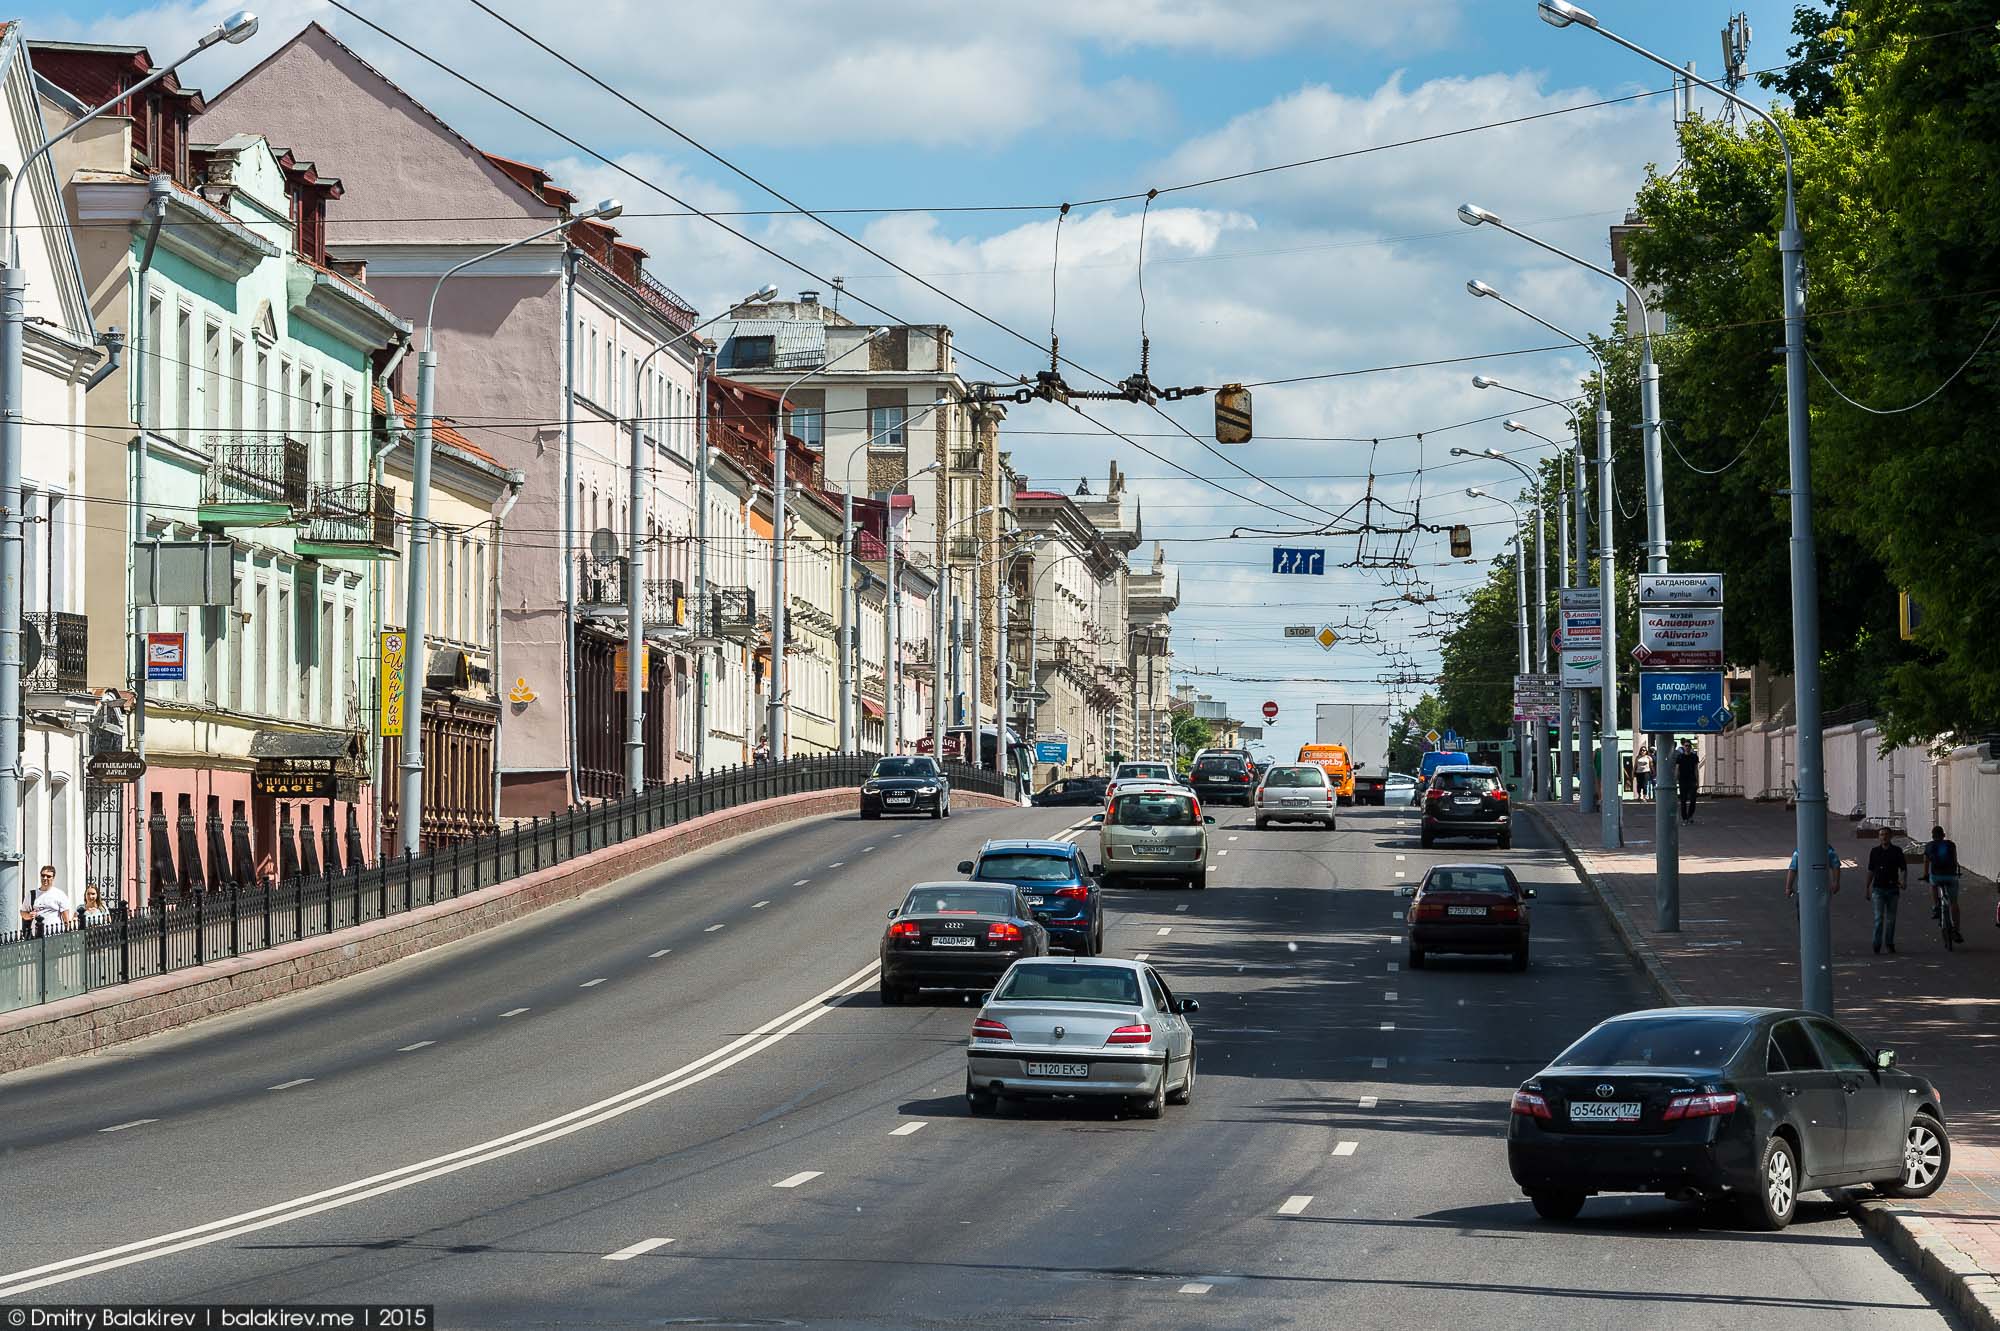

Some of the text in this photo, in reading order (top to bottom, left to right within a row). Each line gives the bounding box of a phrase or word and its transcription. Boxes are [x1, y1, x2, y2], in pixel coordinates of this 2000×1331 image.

[1655, 579, 1708, 587] БАГДАНОВІЧА
[1289, 628, 1311, 636] STOP
[1656, 683, 1707, 691] БЛАГОДАРИМ
[1663, 693, 1712, 701] КУЛЬТУРНОЕ
[266, 785, 314, 793] КАФЕ
[1038, 1063, 1087, 1075] 1120 EK-5
[1621, 1103, 1638, 1114] 177
